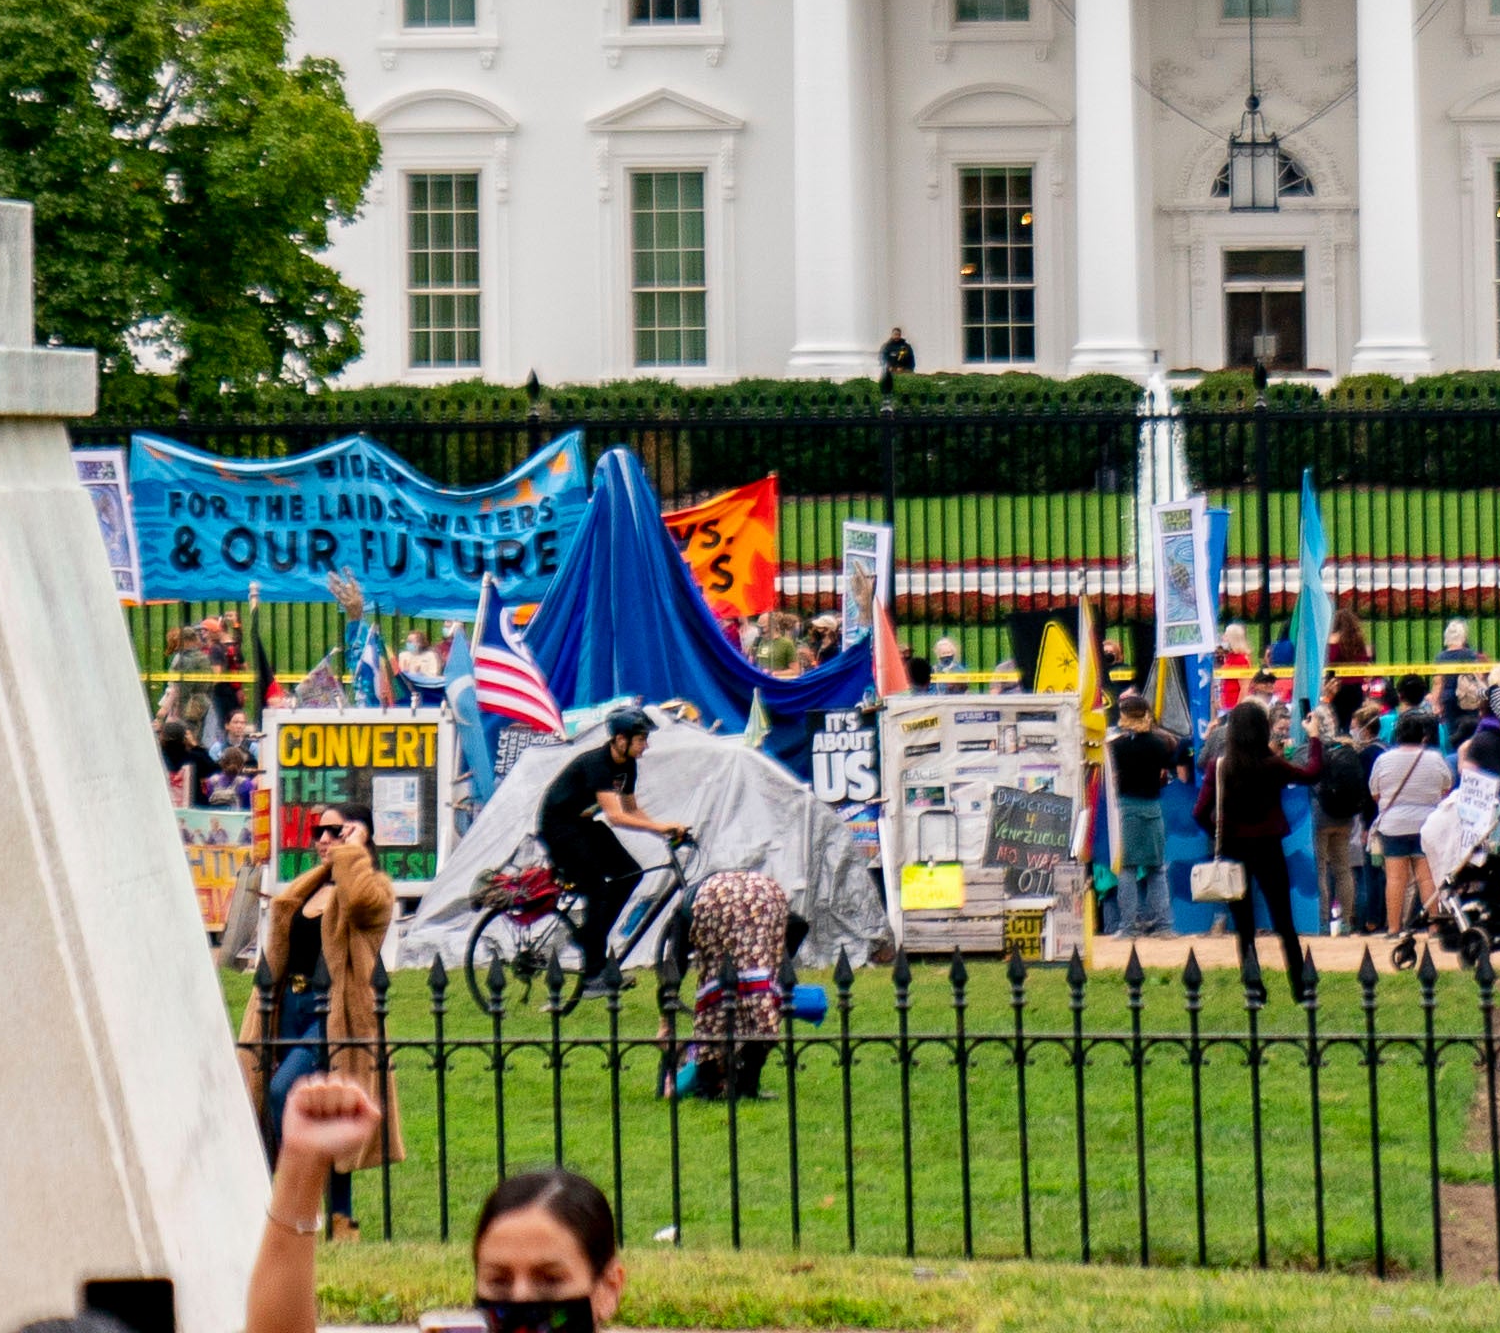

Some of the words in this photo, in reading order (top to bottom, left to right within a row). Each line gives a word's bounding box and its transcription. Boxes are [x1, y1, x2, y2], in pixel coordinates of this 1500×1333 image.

[168, 491, 229, 520] FOR
[244, 493, 302, 521] THE
[426, 496, 555, 534] WATERS
[169, 525, 202, 571] &
[220, 527, 338, 574] OUR
[361, 529, 559, 581] FUTURE
[813, 731, 874, 753] ABOUT
[825, 712, 858, 732] IT'S
[278, 724, 438, 767] CONVERT
[495, 730, 510, 774] BLACK
[505, 730, 519, 774] ATHERS
[279, 769, 349, 802] THE
[812, 751, 878, 803] US
[280, 806, 322, 849] WA
[1026, 813, 1036, 829] 4
[996, 844, 1018, 865] NO
